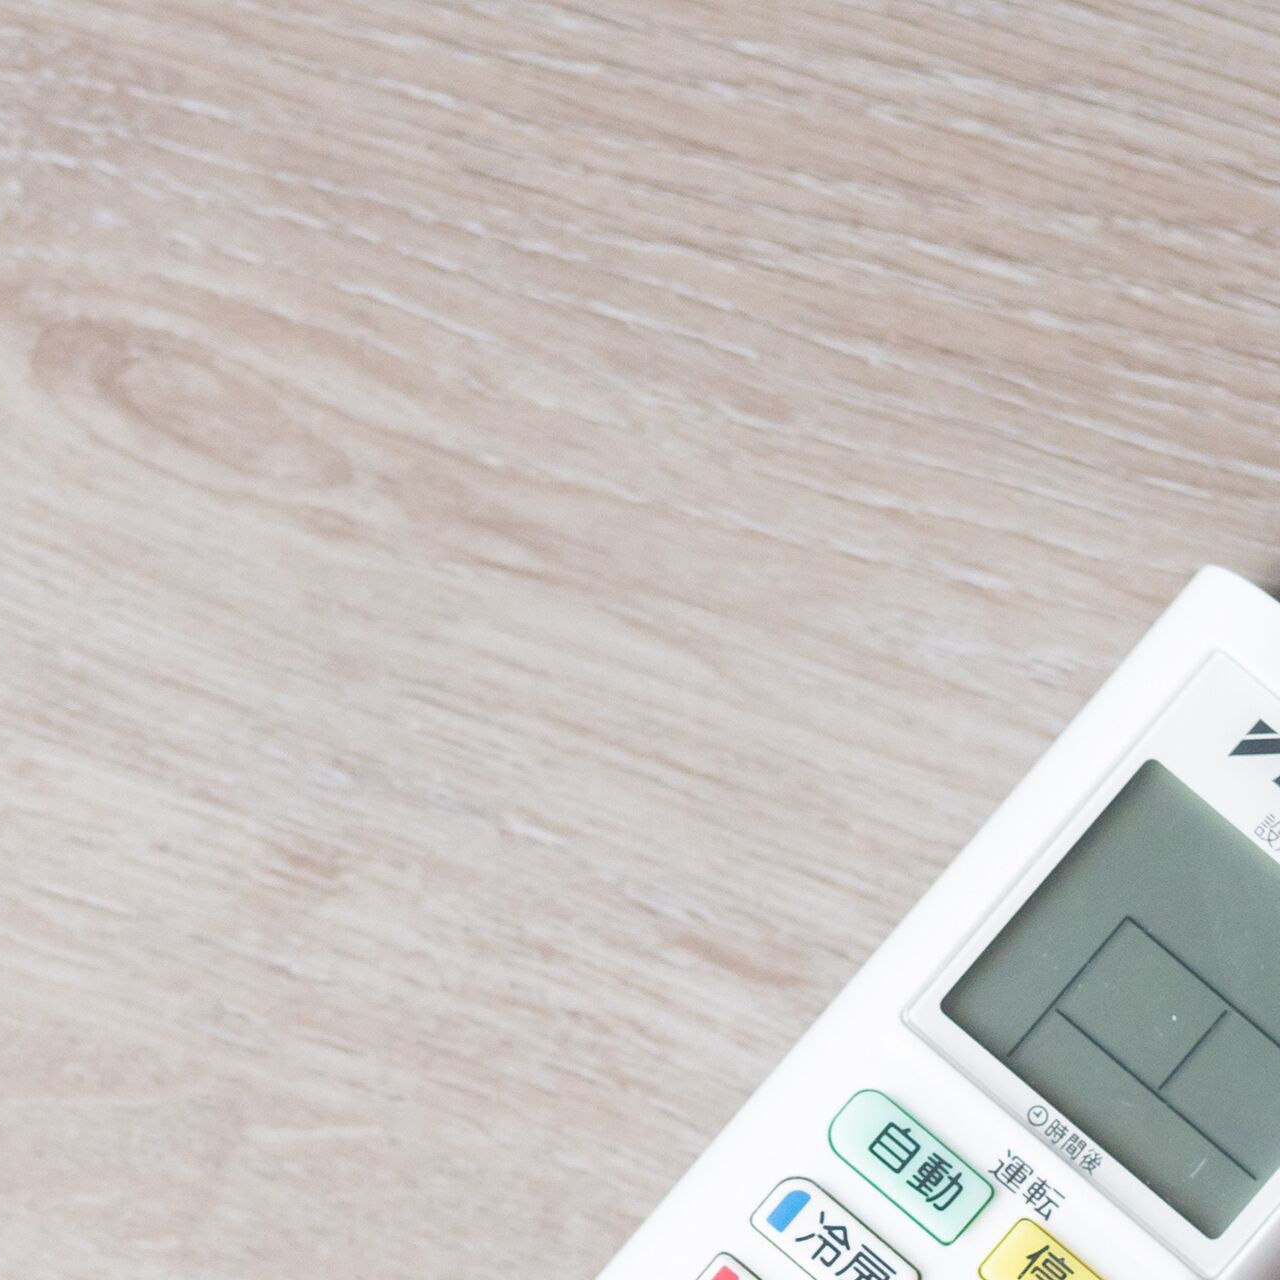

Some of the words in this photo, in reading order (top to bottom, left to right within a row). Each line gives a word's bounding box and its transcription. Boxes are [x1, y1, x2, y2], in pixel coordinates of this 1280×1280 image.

[868, 1121, 964, 1212] 自動
[1044, 1118, 1105, 1176] 時間後
[988, 1148, 1066, 1222] 運転
